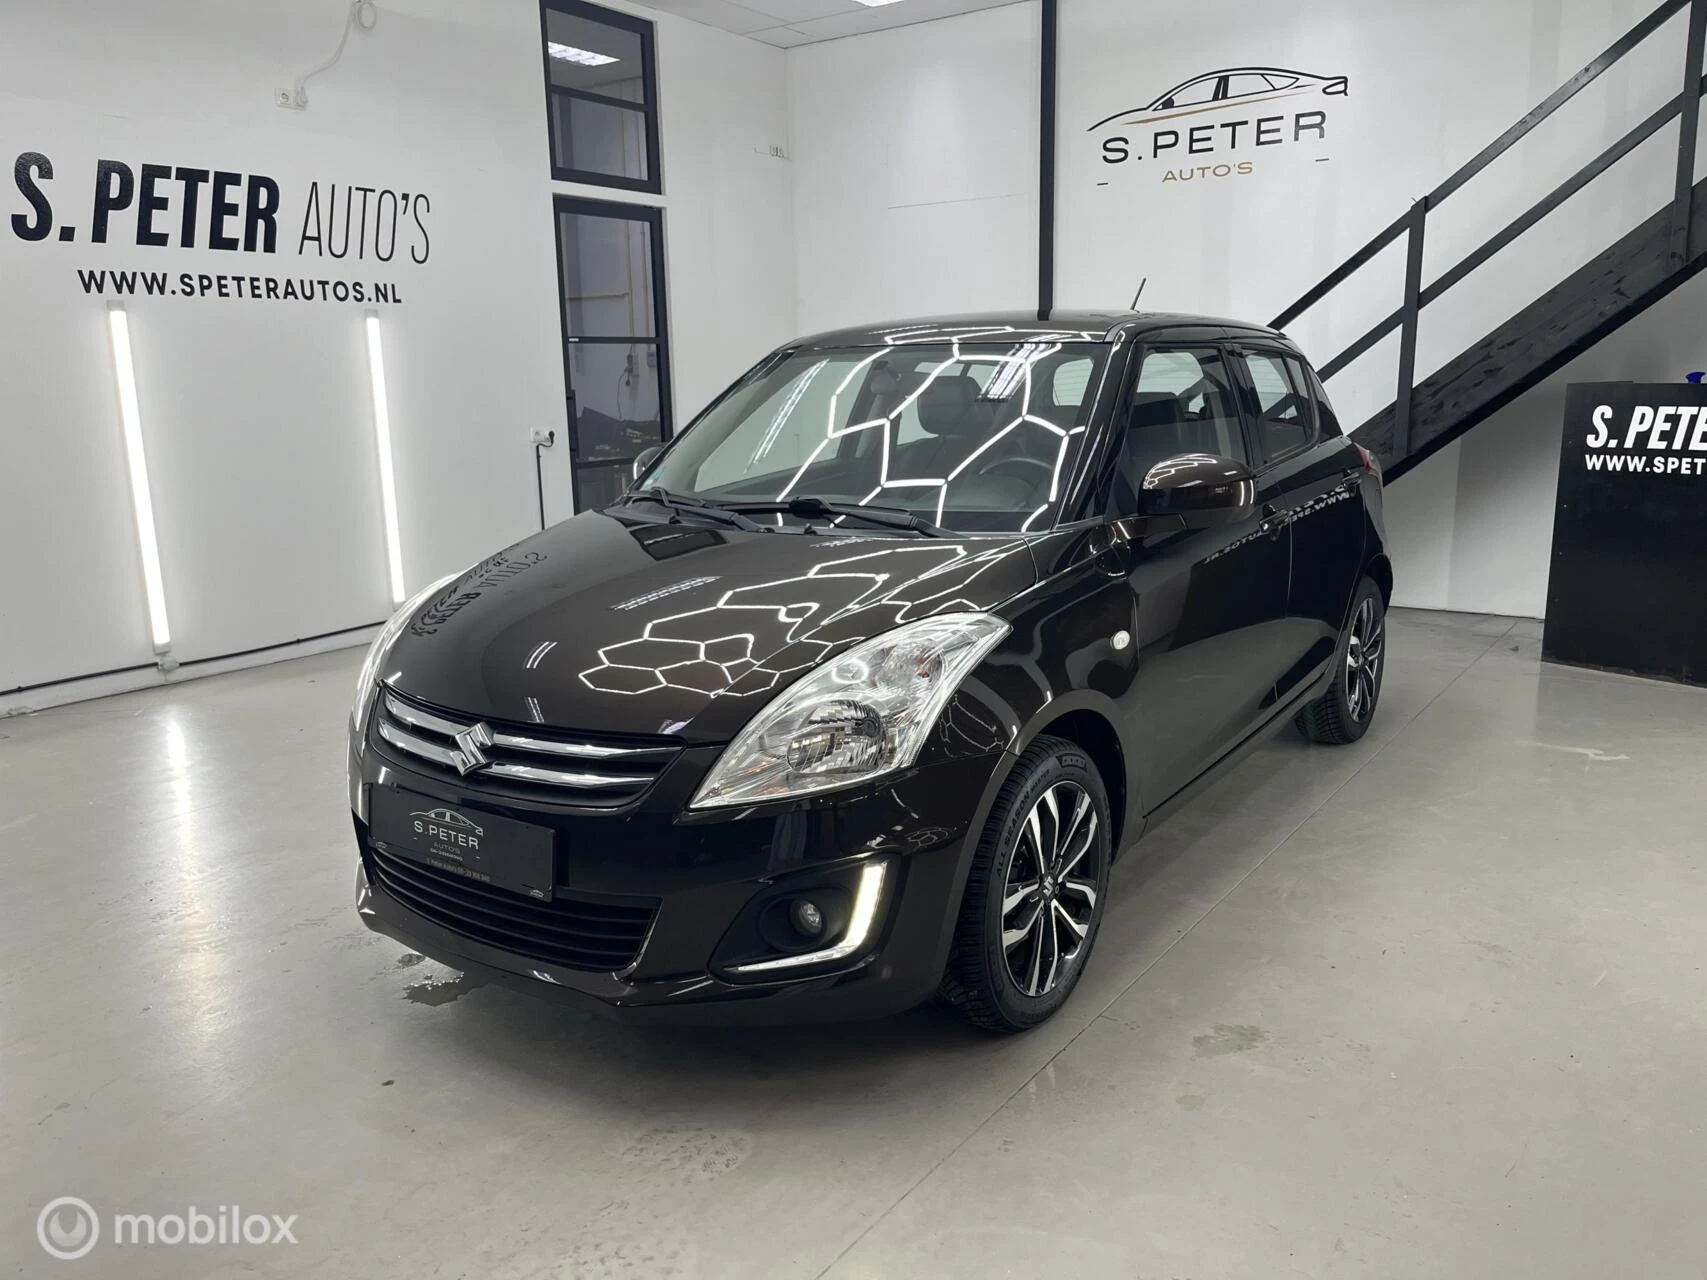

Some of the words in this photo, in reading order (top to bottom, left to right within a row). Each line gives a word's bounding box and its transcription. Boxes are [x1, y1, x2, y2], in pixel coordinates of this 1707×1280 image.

[1162, 161, 1254, 183] AUTO'S
[11, 151, 76, 242] S.
[91, 159, 281, 254] PETER
[299, 181, 432, 265] AUTO'S
[77, 269, 403, 304] WWW.SPETERAUTOS.NL
[1585, 454, 1707, 475] WWW.SPET
[1004, 790, 1030, 847] SEASON
